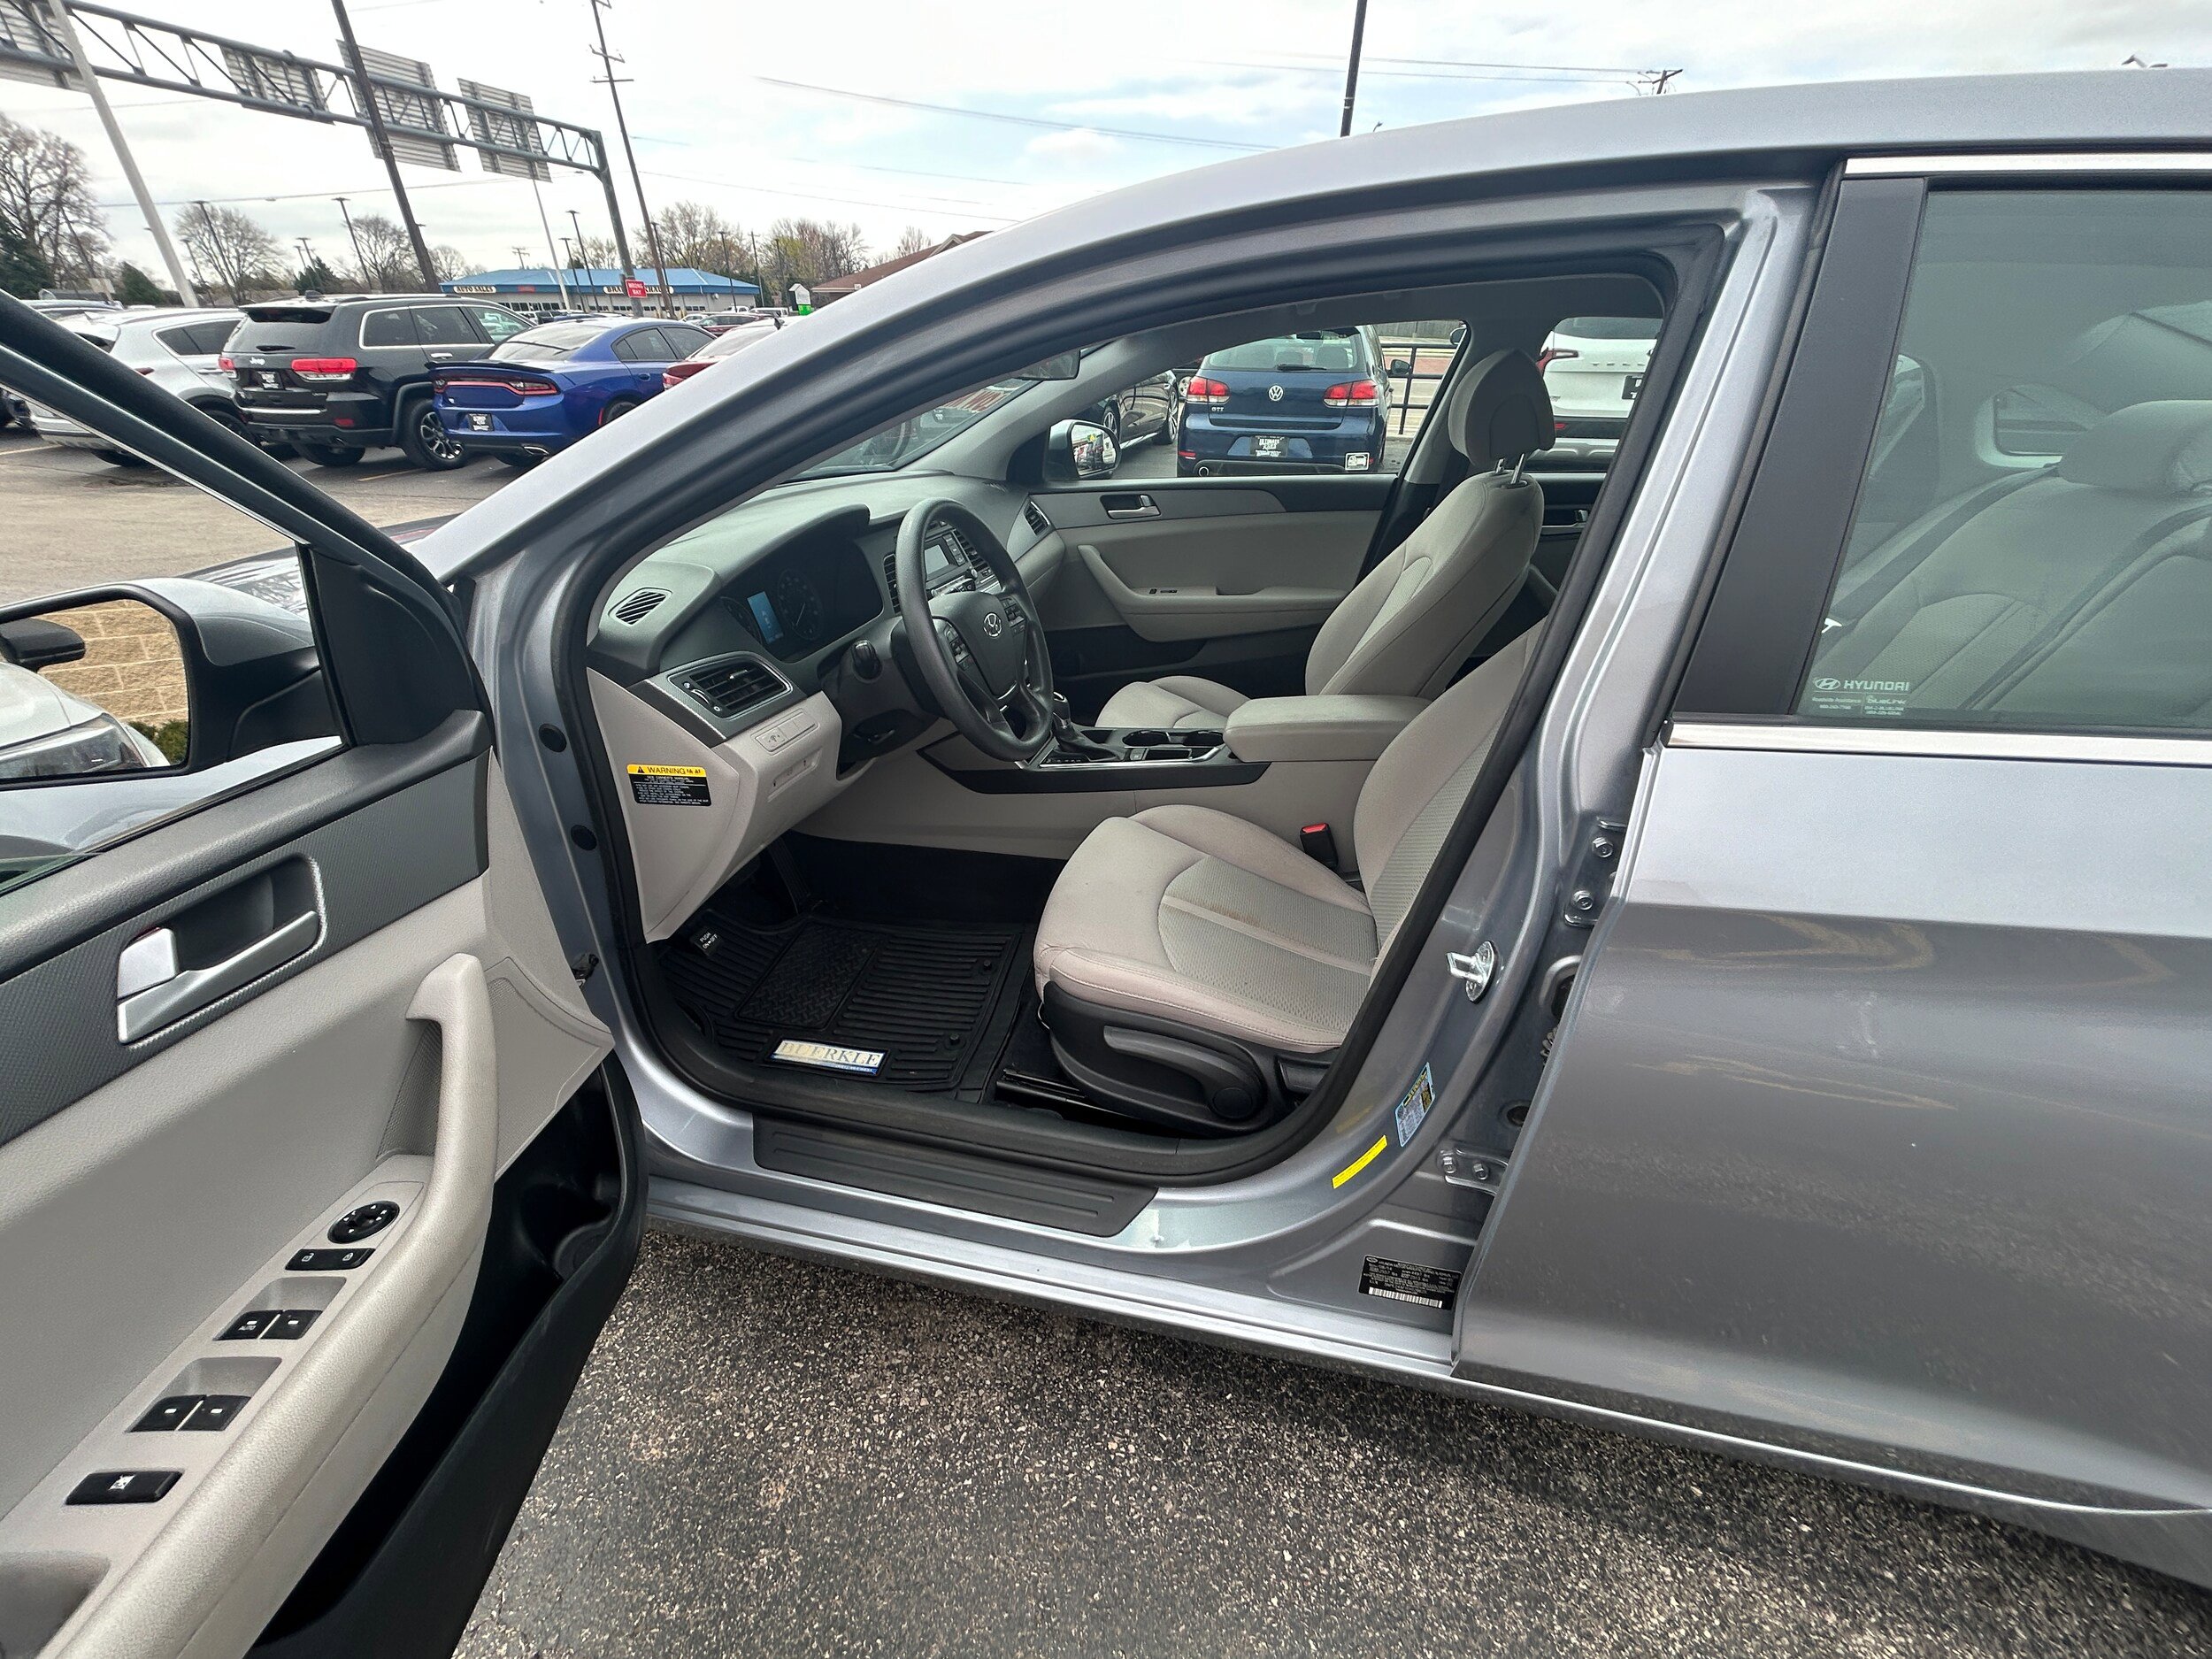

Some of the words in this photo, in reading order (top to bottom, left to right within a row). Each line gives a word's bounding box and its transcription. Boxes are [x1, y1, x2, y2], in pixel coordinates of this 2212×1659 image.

[249, 357, 265, 365] Jeep
[1843, 680, 1910, 691] HYUNDAI
[648, 766, 686, 775] WARNING
